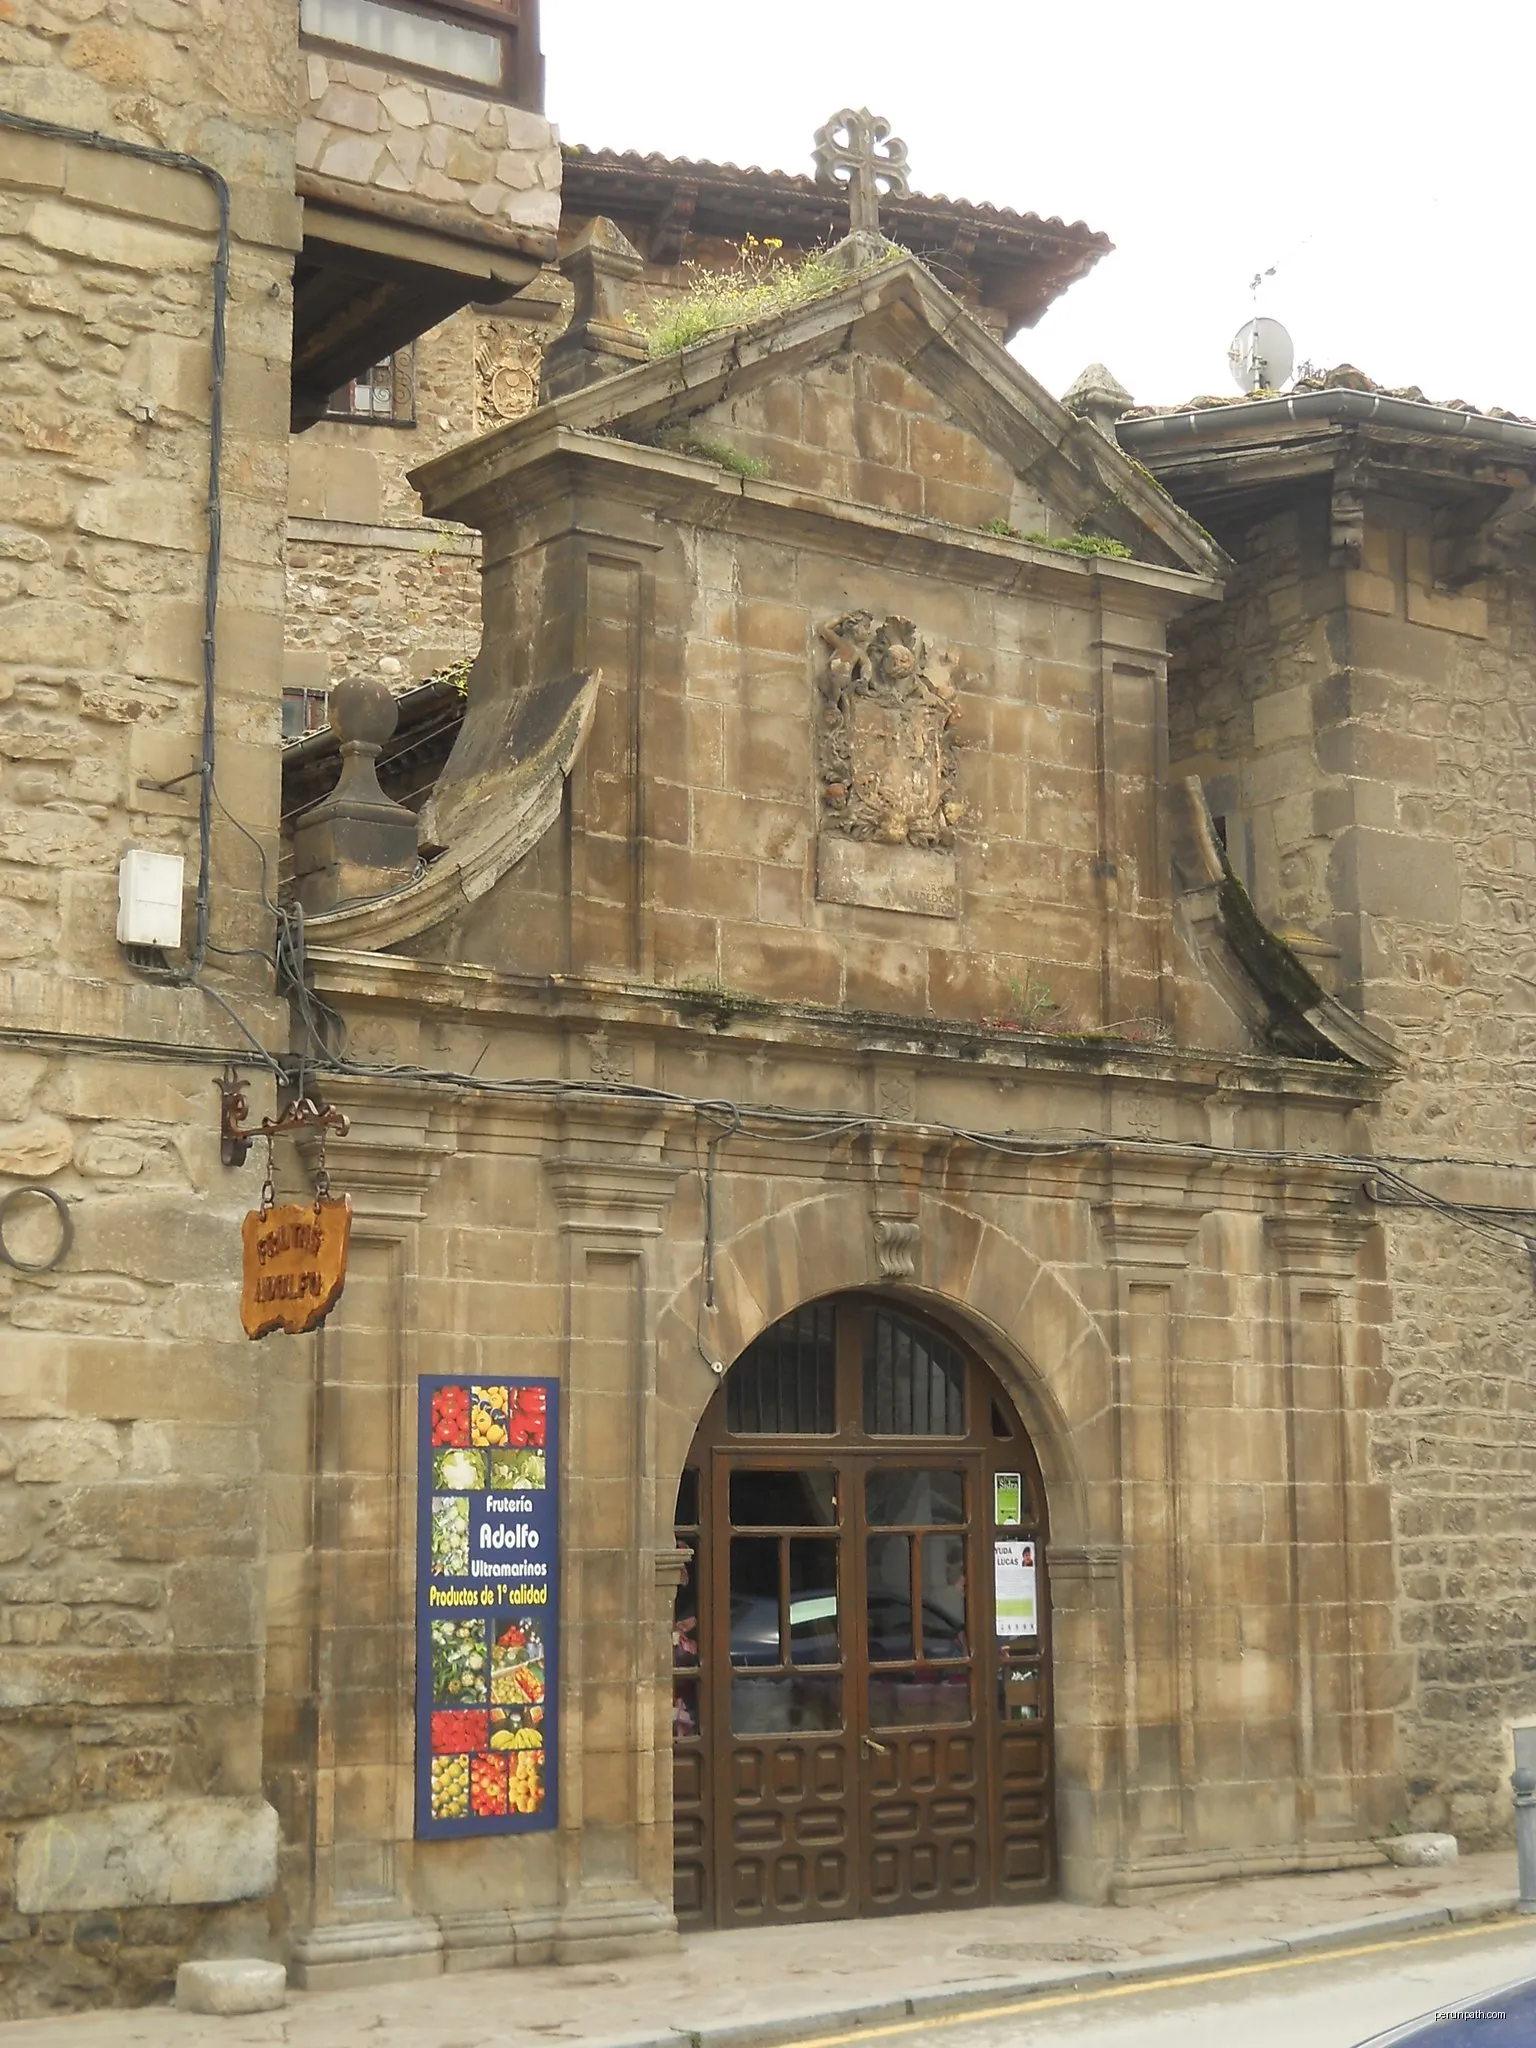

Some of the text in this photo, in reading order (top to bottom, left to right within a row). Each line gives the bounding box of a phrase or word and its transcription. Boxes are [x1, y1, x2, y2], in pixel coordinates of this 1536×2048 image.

[257, 1223, 323, 1266] FRUTAS
[255, 1271, 322, 1303] ADOLFO
[486, 1495, 533, 1512] Frutería
[480, 1523, 539, 1549] Adolfo
[471, 1559, 548, 1577] Ultramarinos
[997, 1558, 1019, 1566] LUCAS
[429, 1585, 479, 1607] Productos
[480, 1584, 494, 1605] de
[509, 1583, 547, 1605] calidad
